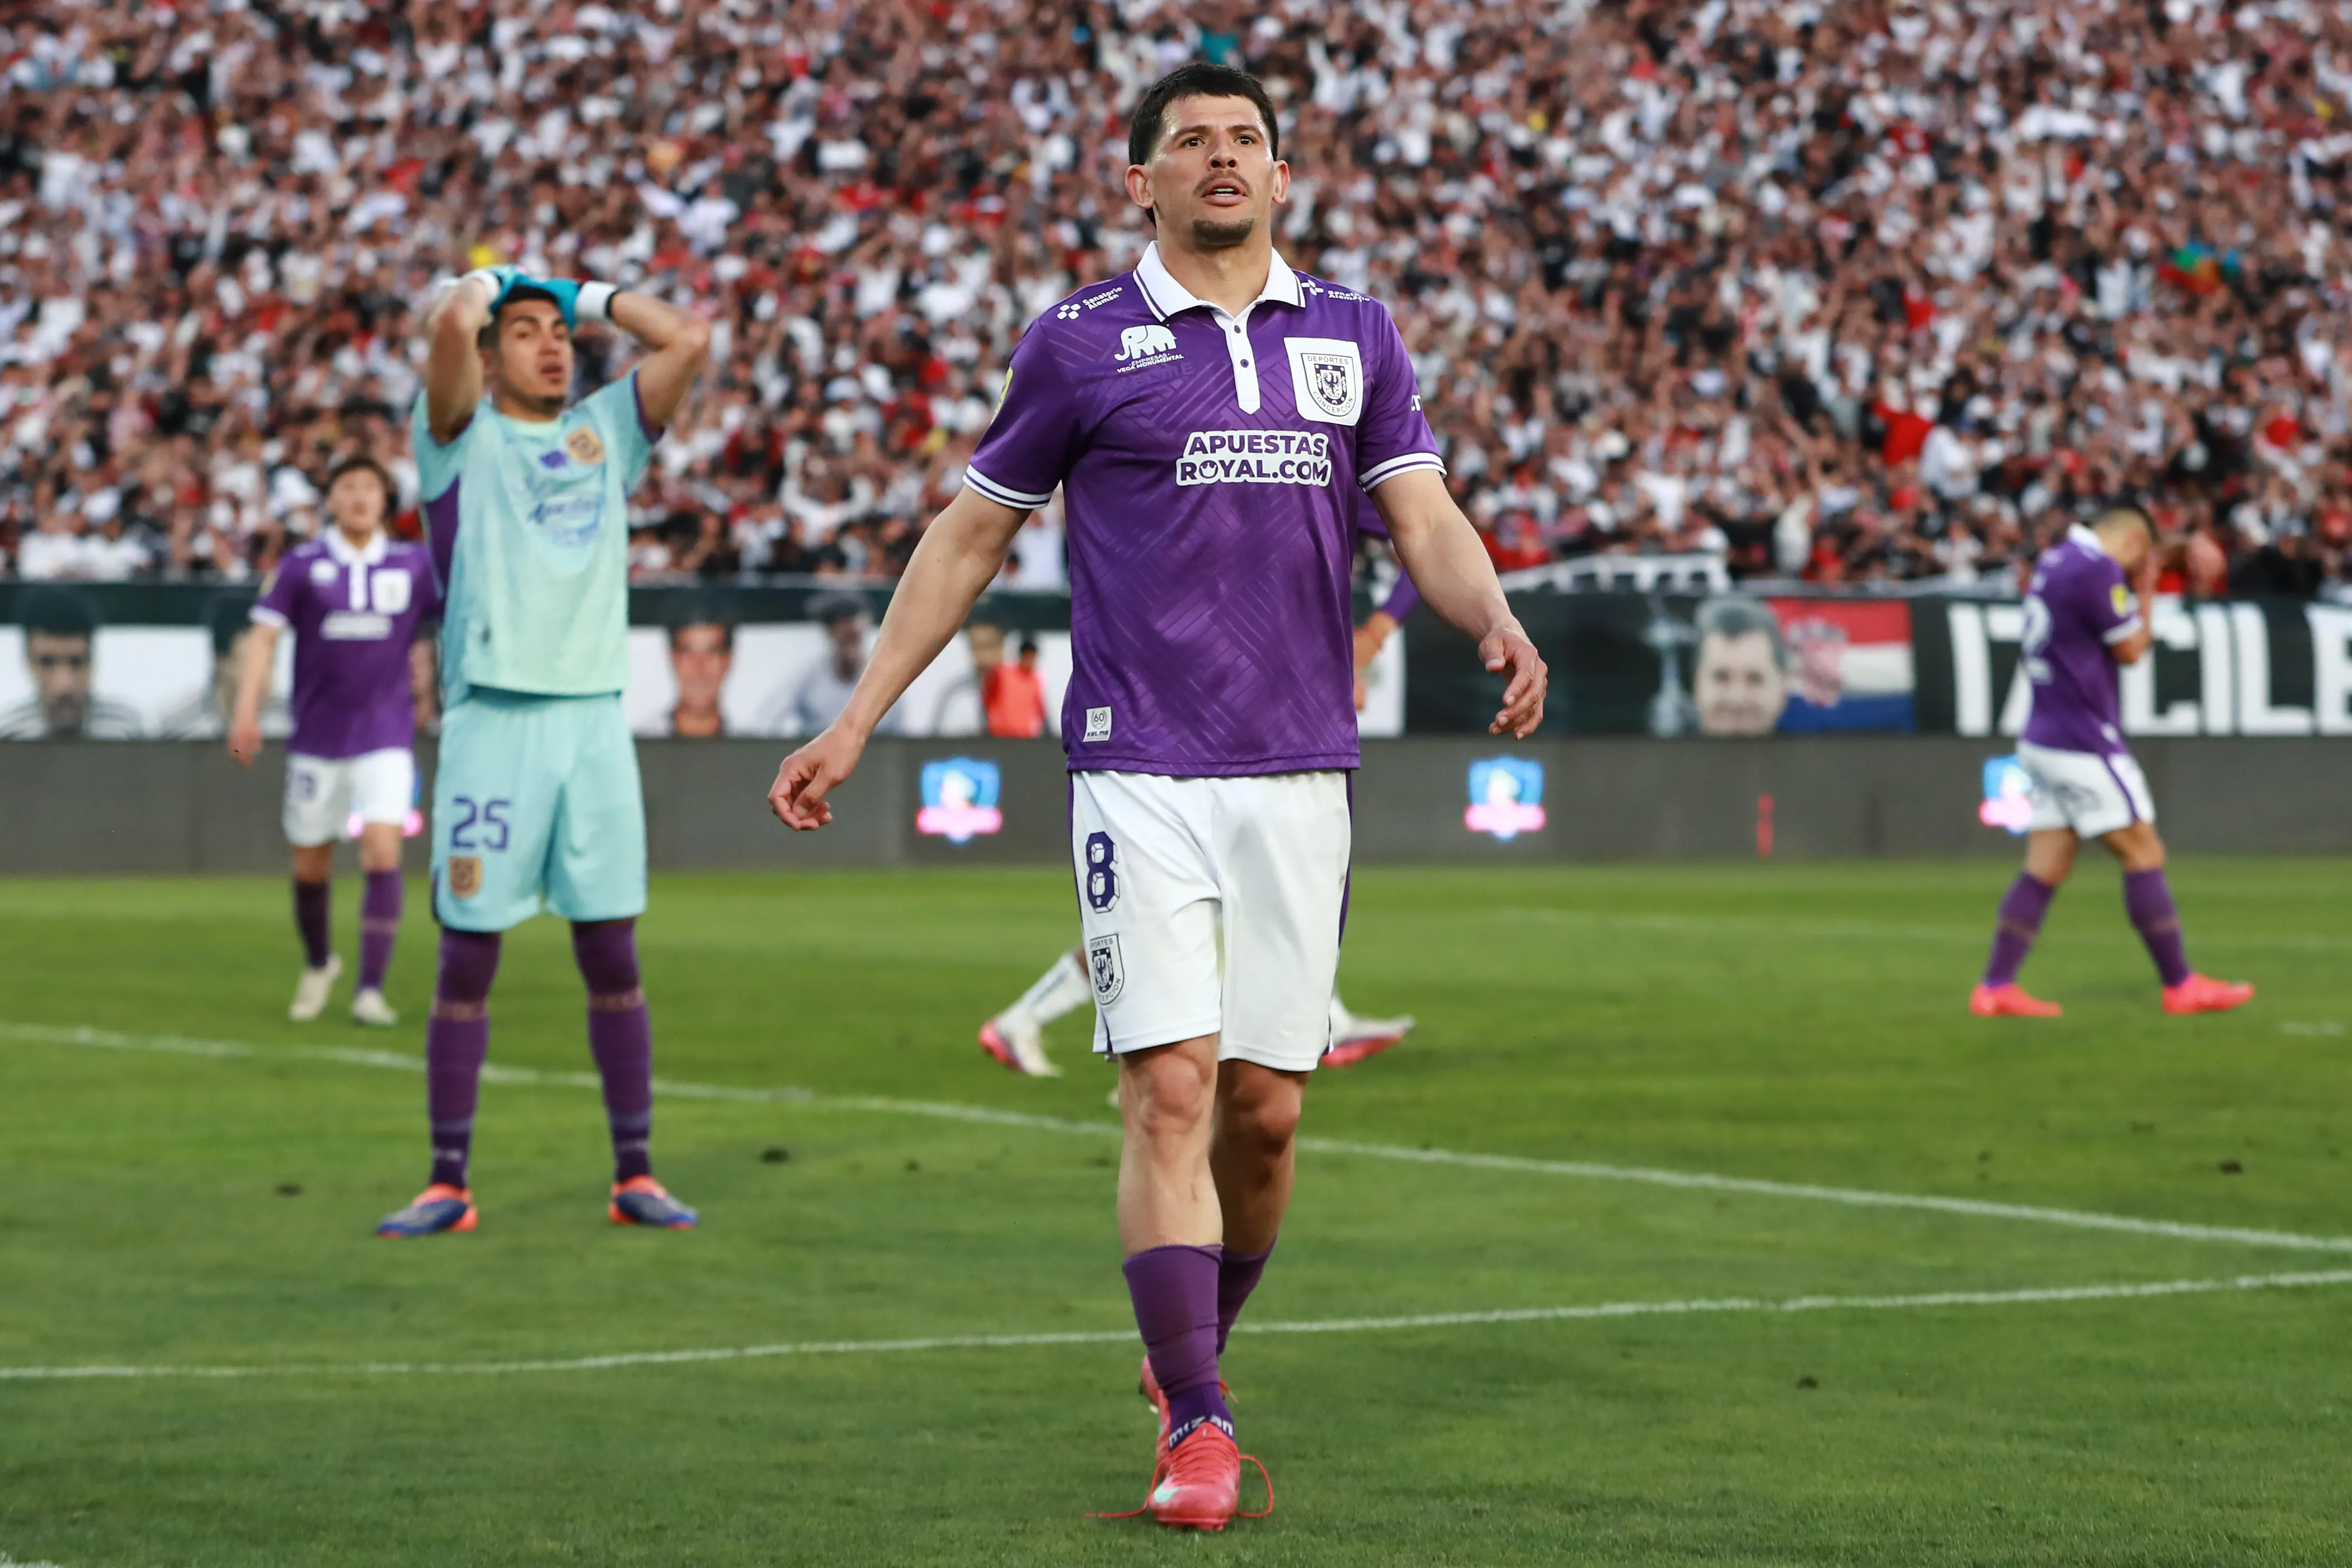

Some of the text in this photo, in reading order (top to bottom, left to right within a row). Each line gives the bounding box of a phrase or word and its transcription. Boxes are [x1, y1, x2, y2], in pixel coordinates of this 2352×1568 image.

[1082, 286, 1123, 305] Sanatorio
[1117, 354, 1184, 373] VEGA MONUMENTAL
[1130, 352, 1168, 366] EMPRESAS
[1307, 355, 1349, 365] DEPORTES
[1313, 391, 1354, 413] CONCEPCION
[1188, 435, 1325, 457] APUESTAS
[1180, 459, 1329, 482] ROYAL.COM
[1094, 713, 1104, 723] 60
[450, 795, 511, 853] 25
[1085, 831, 1121, 914] 8
